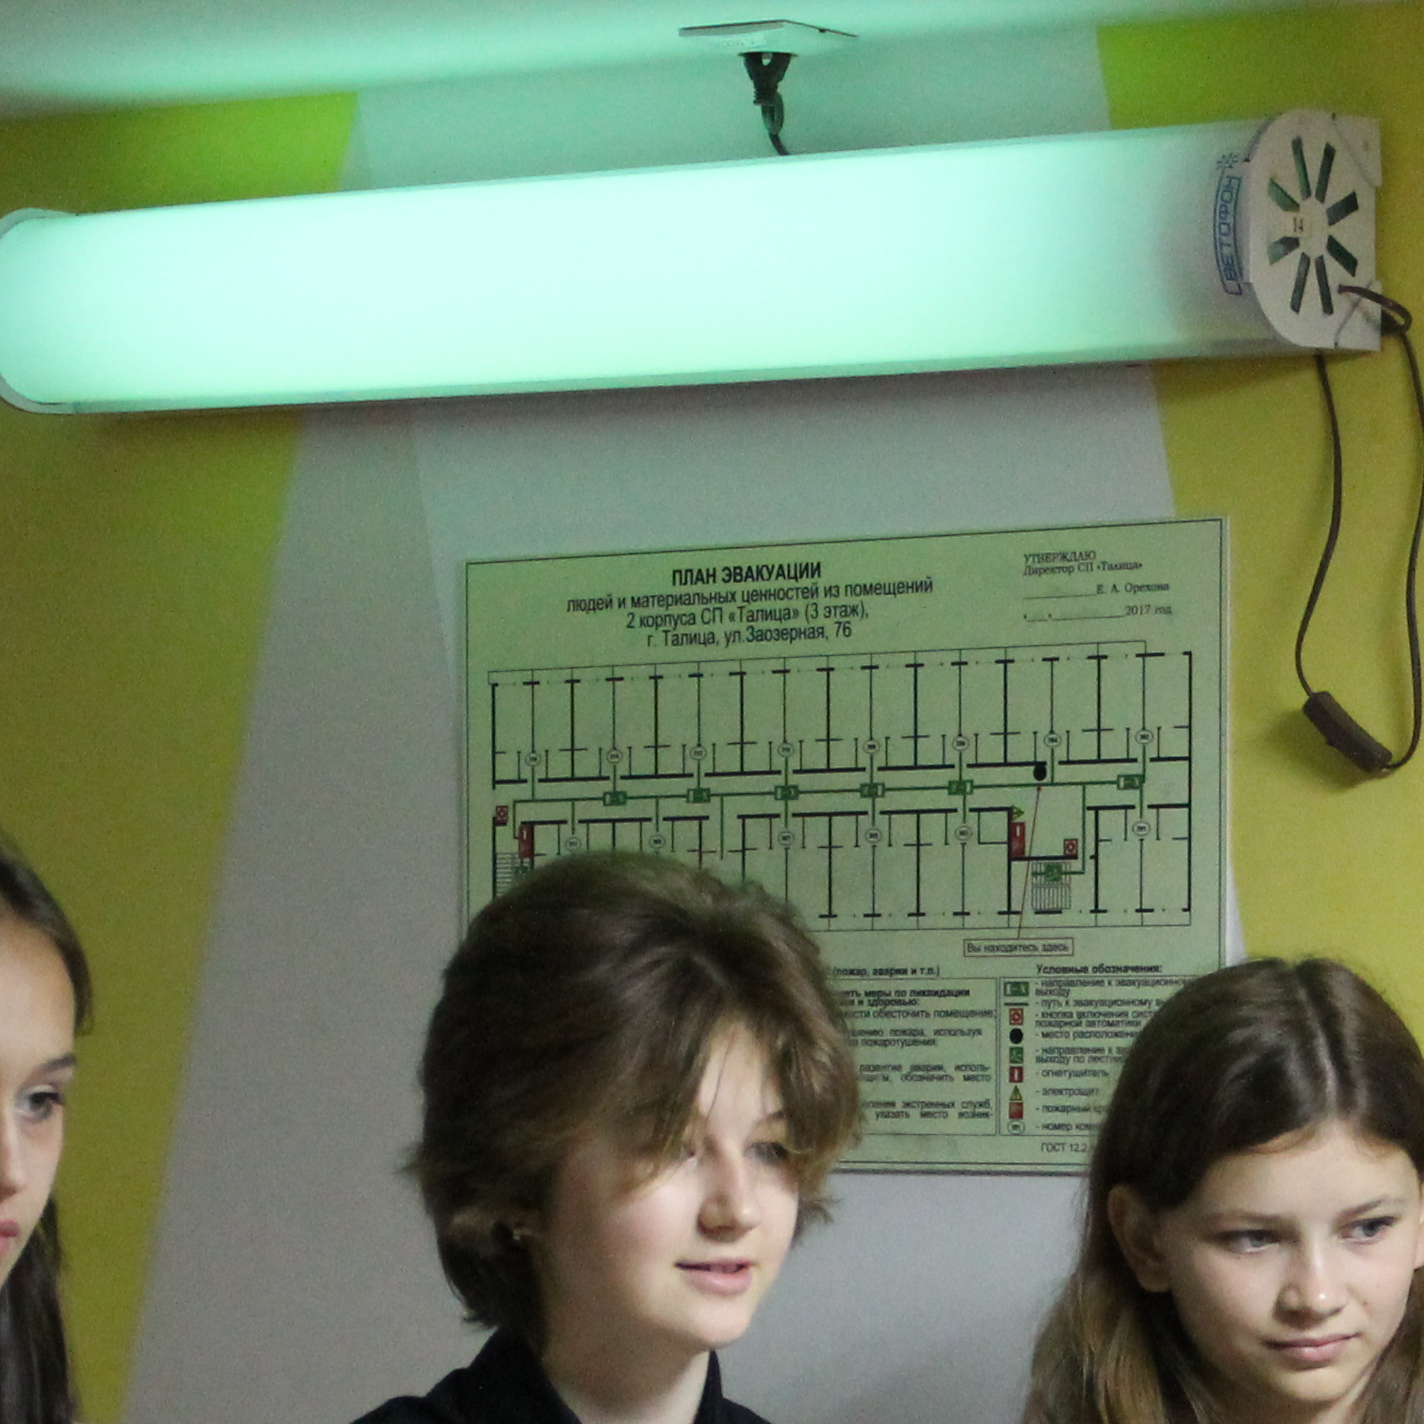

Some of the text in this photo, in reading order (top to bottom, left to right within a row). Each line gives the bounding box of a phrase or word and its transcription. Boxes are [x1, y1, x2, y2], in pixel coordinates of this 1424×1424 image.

[1023, 551, 1097, 564] УТВЕРЖДАЮ
[672, 562, 822, 586] ПЛАН ЭВАКУАЦИИ
[1023, 564, 1075, 577] Директор
[1077, 562, 1094, 573] СП
[566, 577, 934, 613] людей и материальных ценностей из помещений
[626, 612, 635, 629] 2
[639, 613, 697, 630] корпуса
[701, 606, 724, 625] СП
[728, 605, 799, 624] «Талица»
[805, 602, 819, 624] (3
[1154, 605, 1172, 616] год
[647, 634, 658, 647] г.
[662, 629, 720, 647] Талица,
[834, 620, 852, 638] 76
[967, 942, 1069, 954] Вы находитесь здесь
[1036, 963, 1163, 975] Условные обозначения:
[1041, 1142, 1067, 1153] ГОСТ
